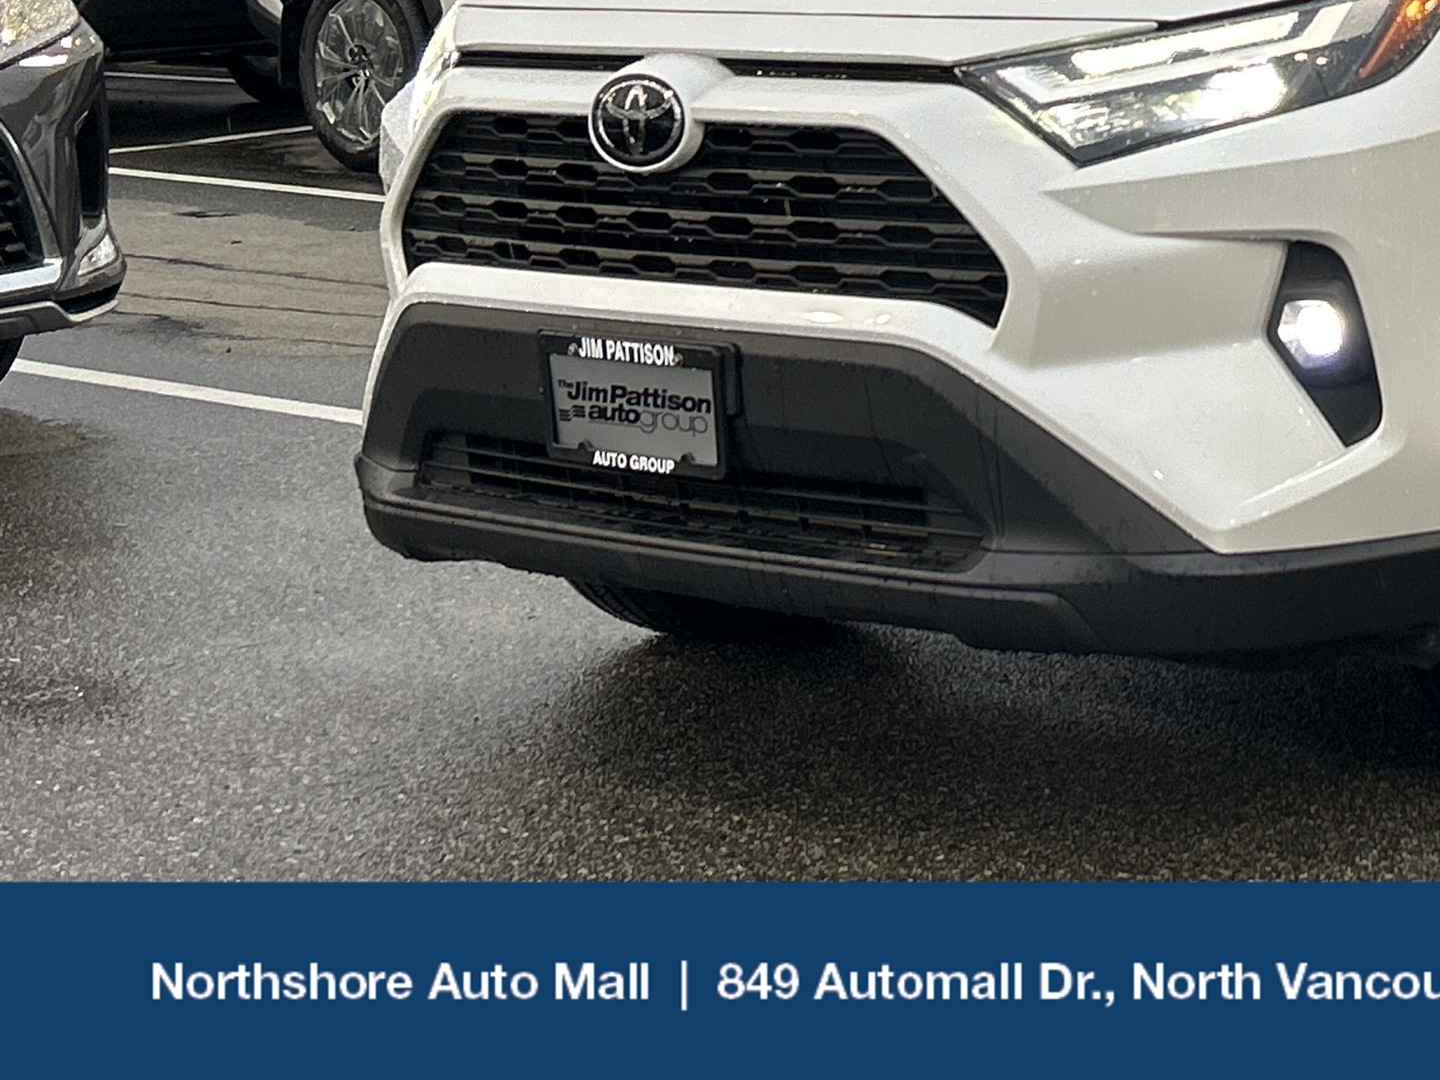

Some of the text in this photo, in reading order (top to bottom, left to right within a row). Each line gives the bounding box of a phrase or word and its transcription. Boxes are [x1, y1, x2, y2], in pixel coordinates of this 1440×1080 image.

[578, 337, 676, 366] JIM PATTISON
[593, 450, 675, 474] AUTO GROUP
